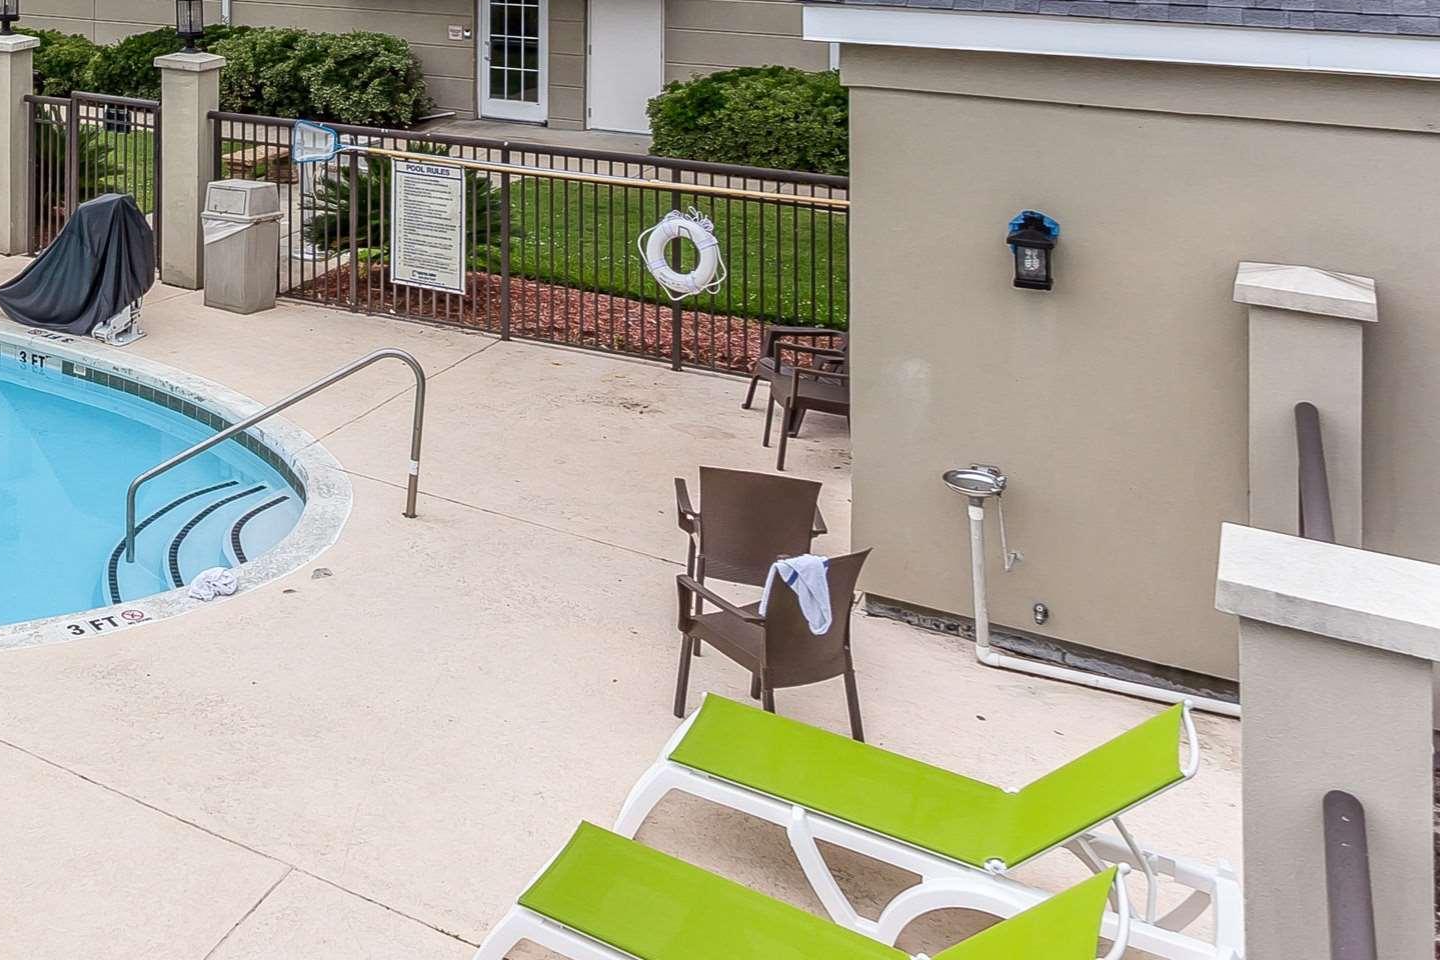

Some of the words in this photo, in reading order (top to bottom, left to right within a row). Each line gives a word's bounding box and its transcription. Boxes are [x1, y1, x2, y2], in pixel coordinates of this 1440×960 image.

[405, 163, 425, 173] POOL
[426, 166, 450, 177] RULES
[19, 350, 27, 363] 3
[31, 353, 46, 369] FT
[66, 624, 86, 636] 3
[88, 615, 120, 632] FT
